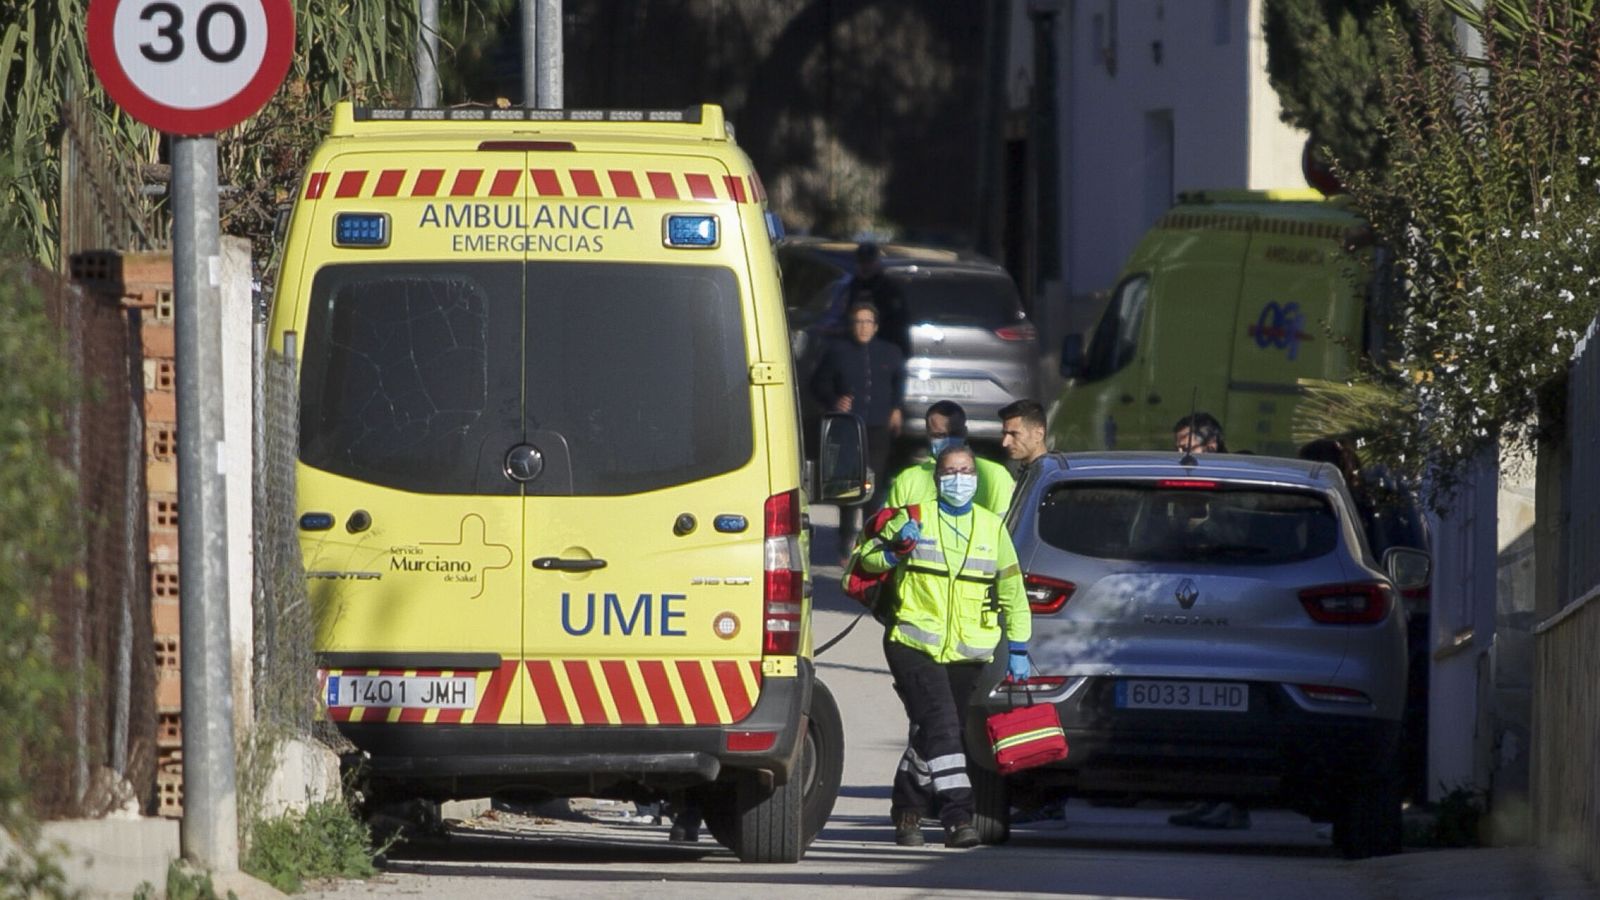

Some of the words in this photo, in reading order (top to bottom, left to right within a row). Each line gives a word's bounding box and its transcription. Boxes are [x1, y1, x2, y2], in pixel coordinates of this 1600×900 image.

[139, 2, 247, 63] 30
[419, 203, 635, 231] AMBULANCIA
[452, 234, 604, 252] EMERGENCIAS
[390, 545, 424, 555] Servicio
[389, 555, 472, 572] Murciano
[304, 570, 383, 581] PRINTER
[443, 574, 454, 582] de
[455, 574, 477, 583] Salud
[561, 592, 687, 636] UME
[1142, 613, 1230, 627] KADJAR
[350, 679, 406, 704] 1401
[420, 681, 467, 705] JMH
[1132, 683, 1191, 706] 6033
[1199, 685, 1243, 708] LHD
